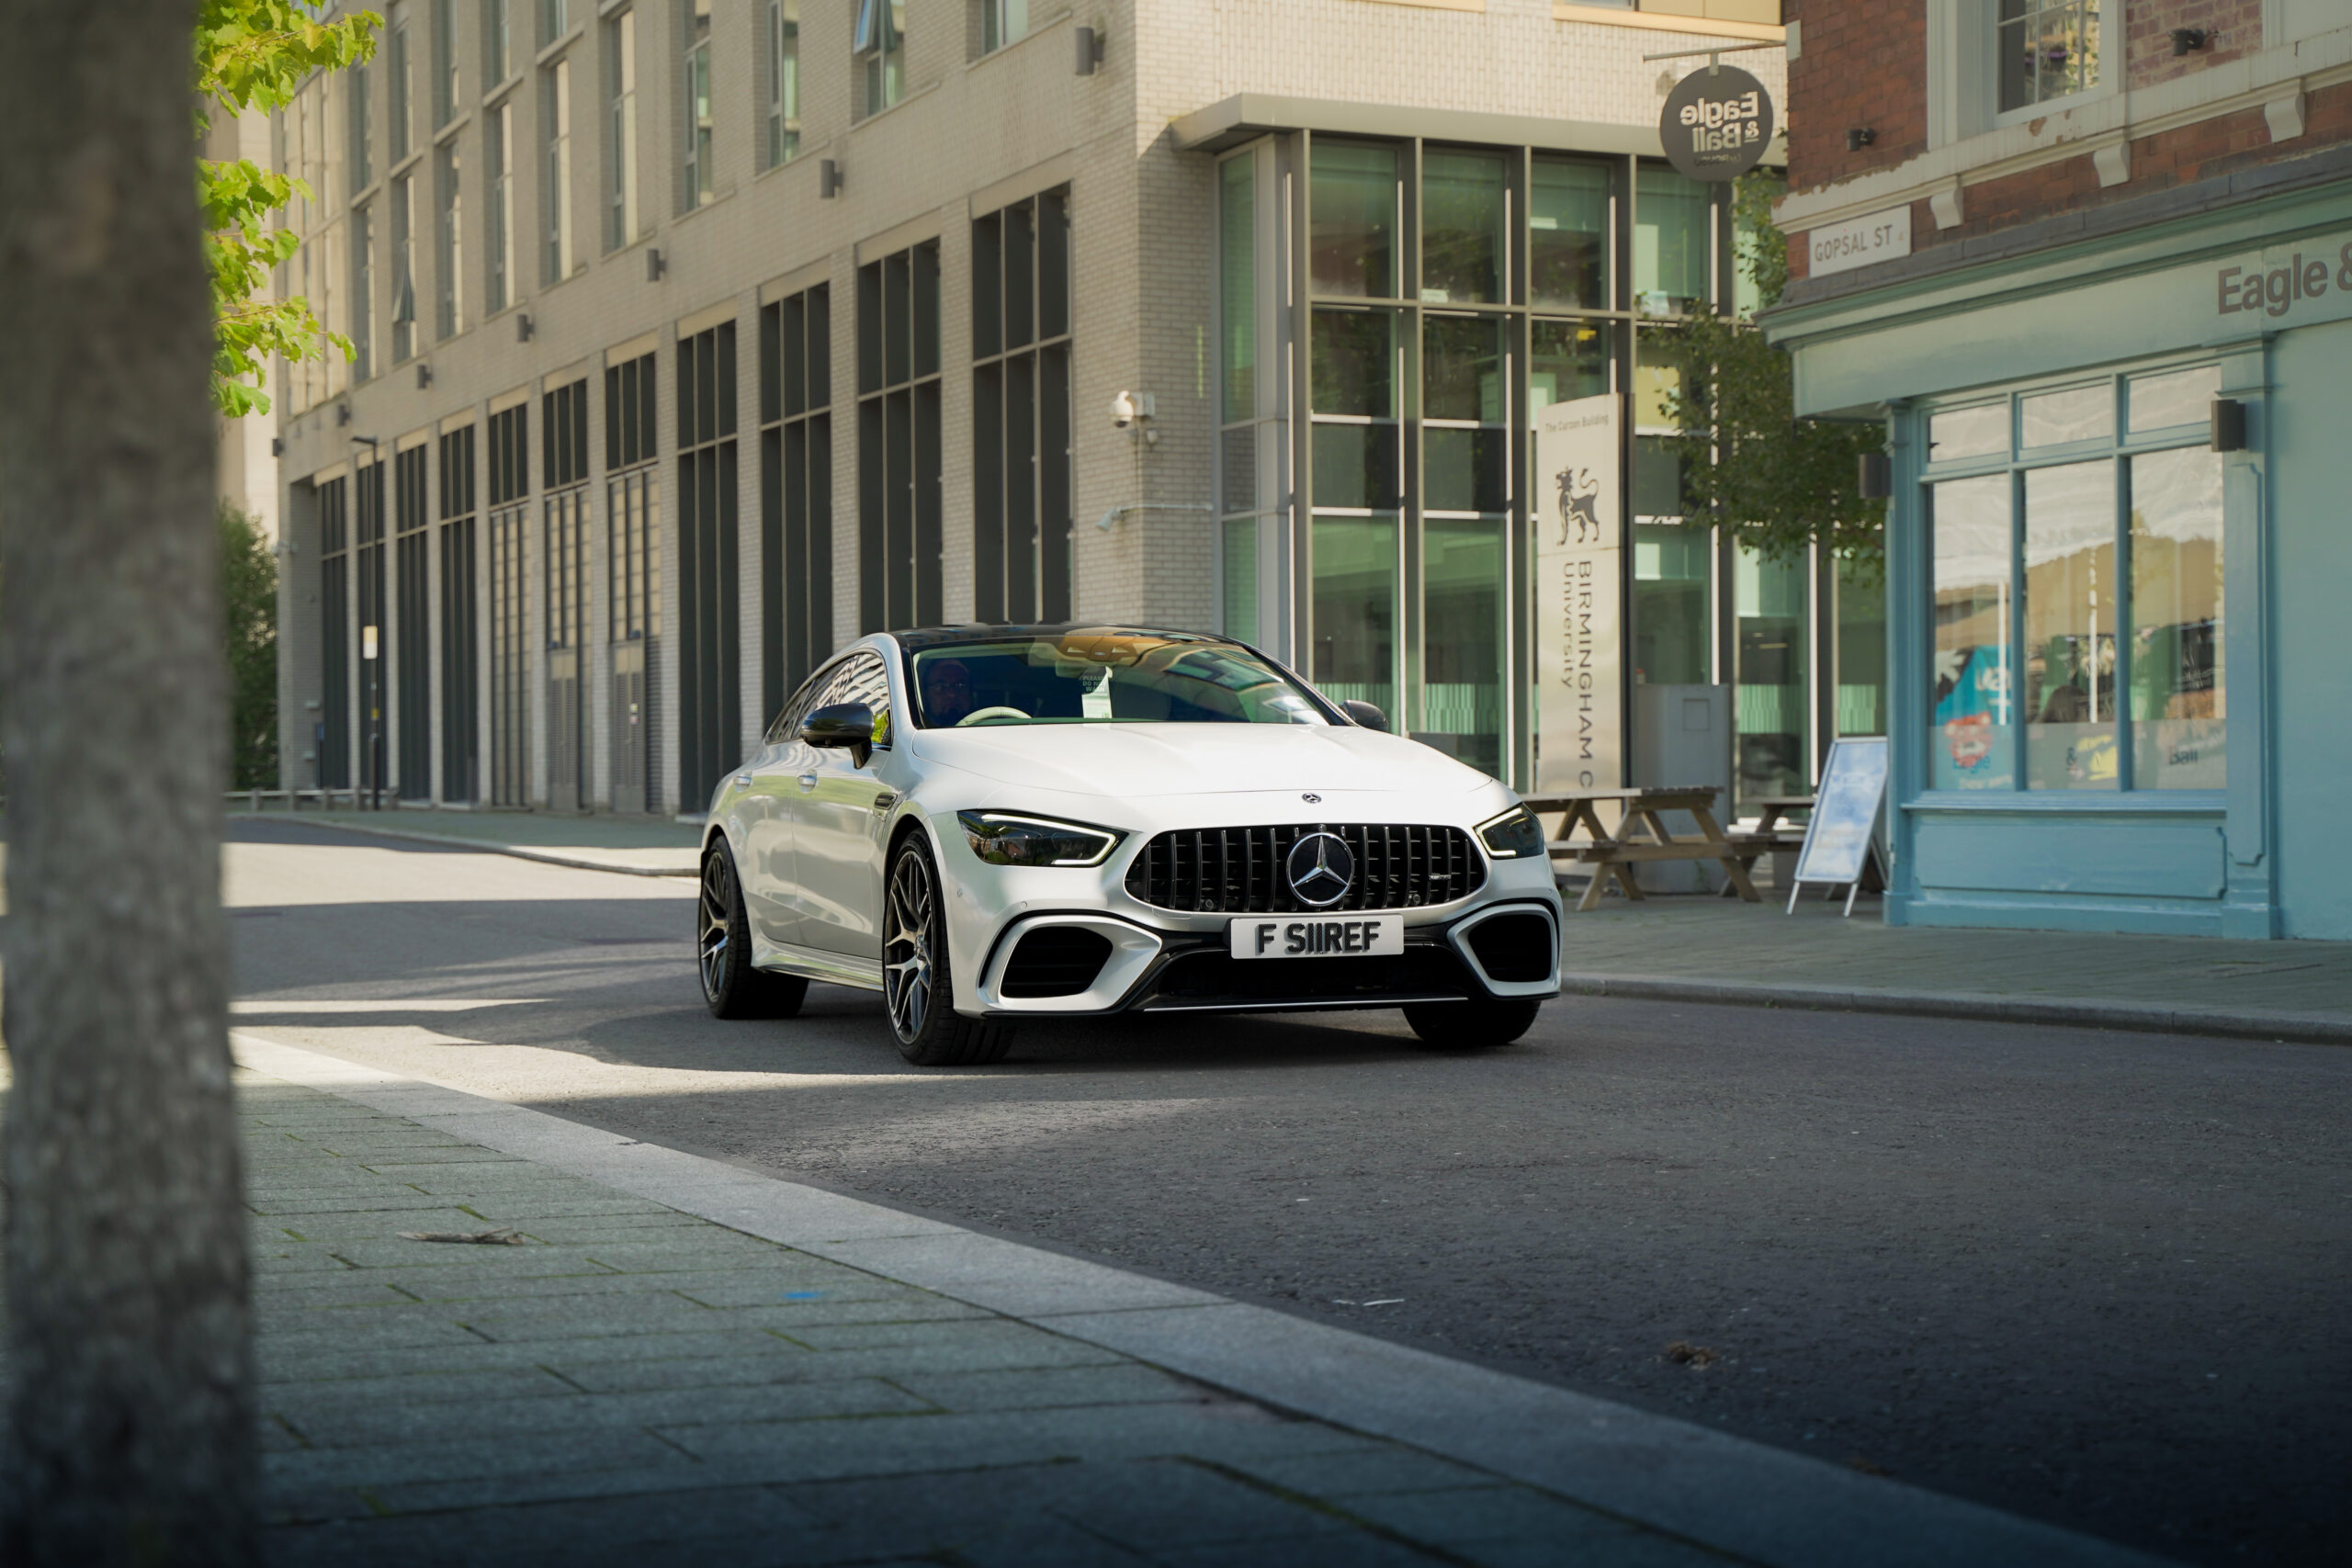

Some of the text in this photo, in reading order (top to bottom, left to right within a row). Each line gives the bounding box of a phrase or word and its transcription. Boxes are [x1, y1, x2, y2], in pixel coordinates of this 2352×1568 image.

[1815, 231, 1868, 262] GOPSAL
[1874, 224, 1893, 247] ST
[2218, 253, 2328, 317] Eagle
[1562, 562, 1575, 688] University
[1578, 561, 1593, 760] BIRMINGHAM
[1258, 923, 1277, 953] F
